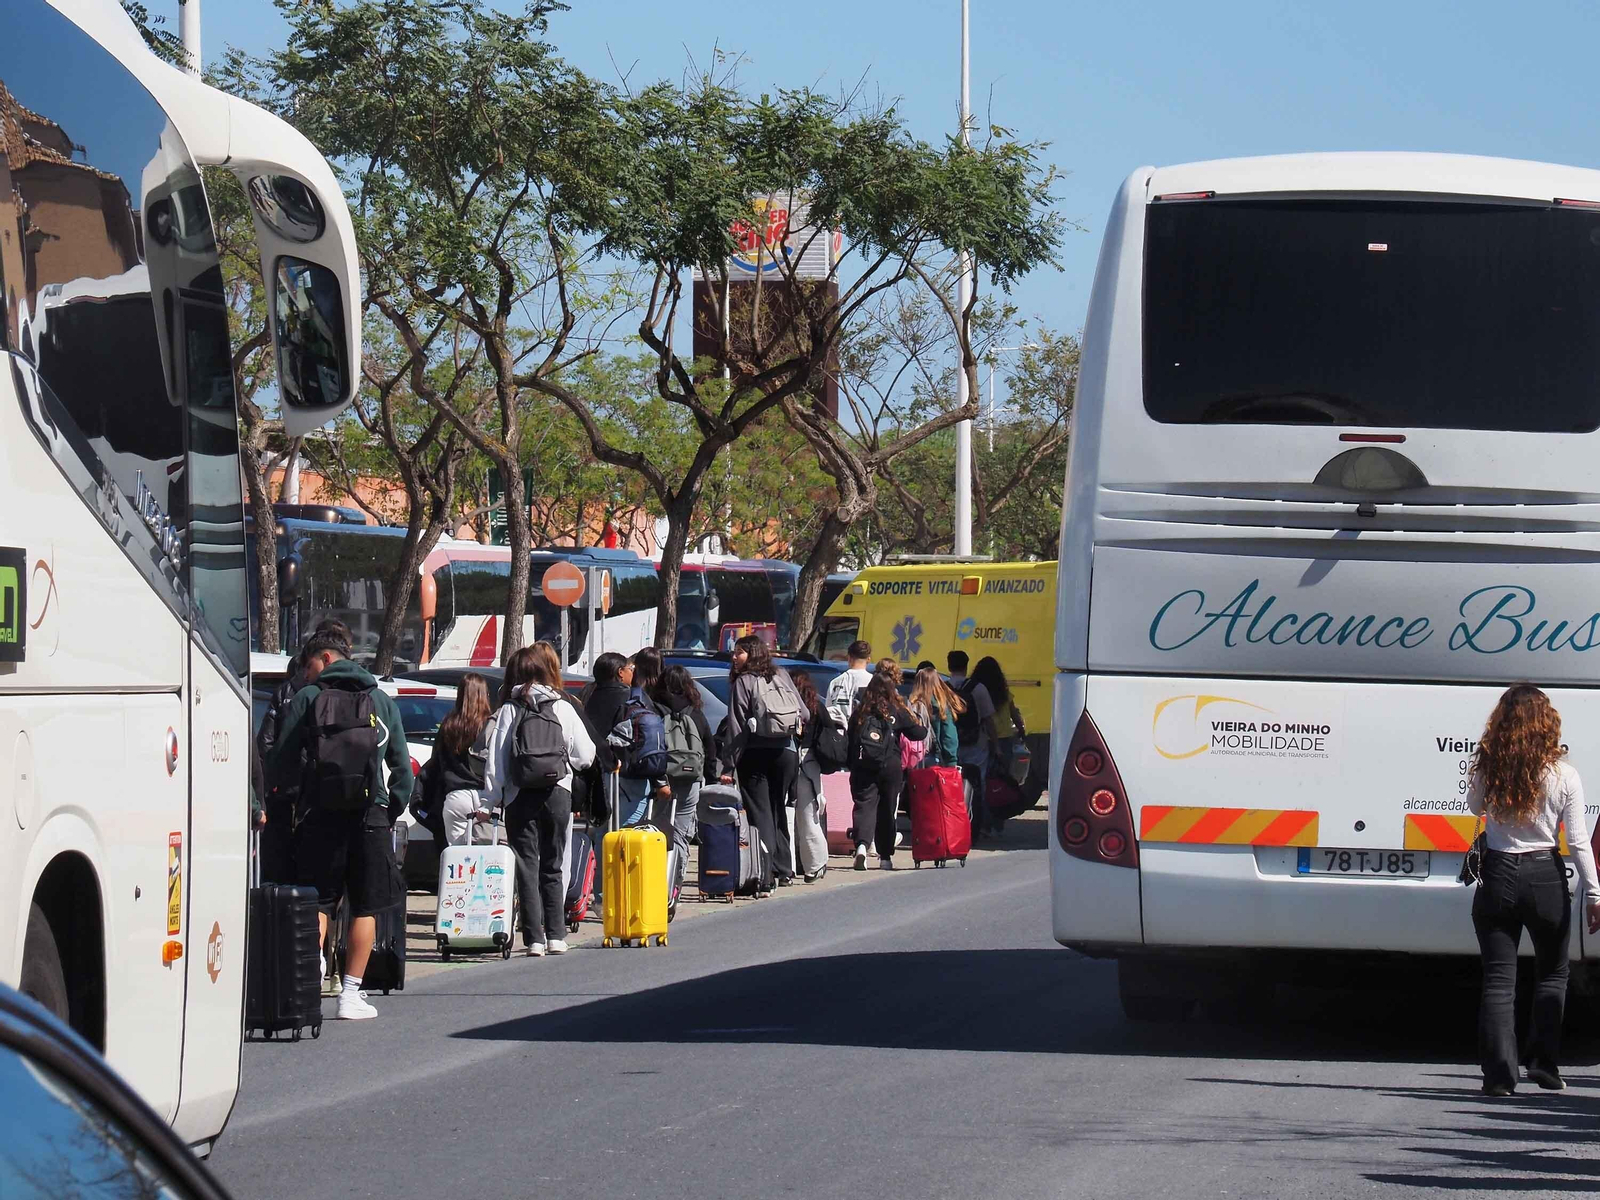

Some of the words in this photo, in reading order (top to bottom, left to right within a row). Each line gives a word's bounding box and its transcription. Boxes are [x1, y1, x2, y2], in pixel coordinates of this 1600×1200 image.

[869, 580, 922, 595] SOPORTE
[928, 580, 961, 595] VITAL
[984, 579, 1045, 594] AVANZADO
[1149, 578, 1435, 651] Alcance
[1211, 721, 1257, 733] VIEIRA
[1261, 722, 1281, 733] DO
[1285, 723, 1331, 735] MINHO
[1211, 734, 1325, 752] MOBILIDADE
[1210, 749, 1247, 757] AUTORIDADE
